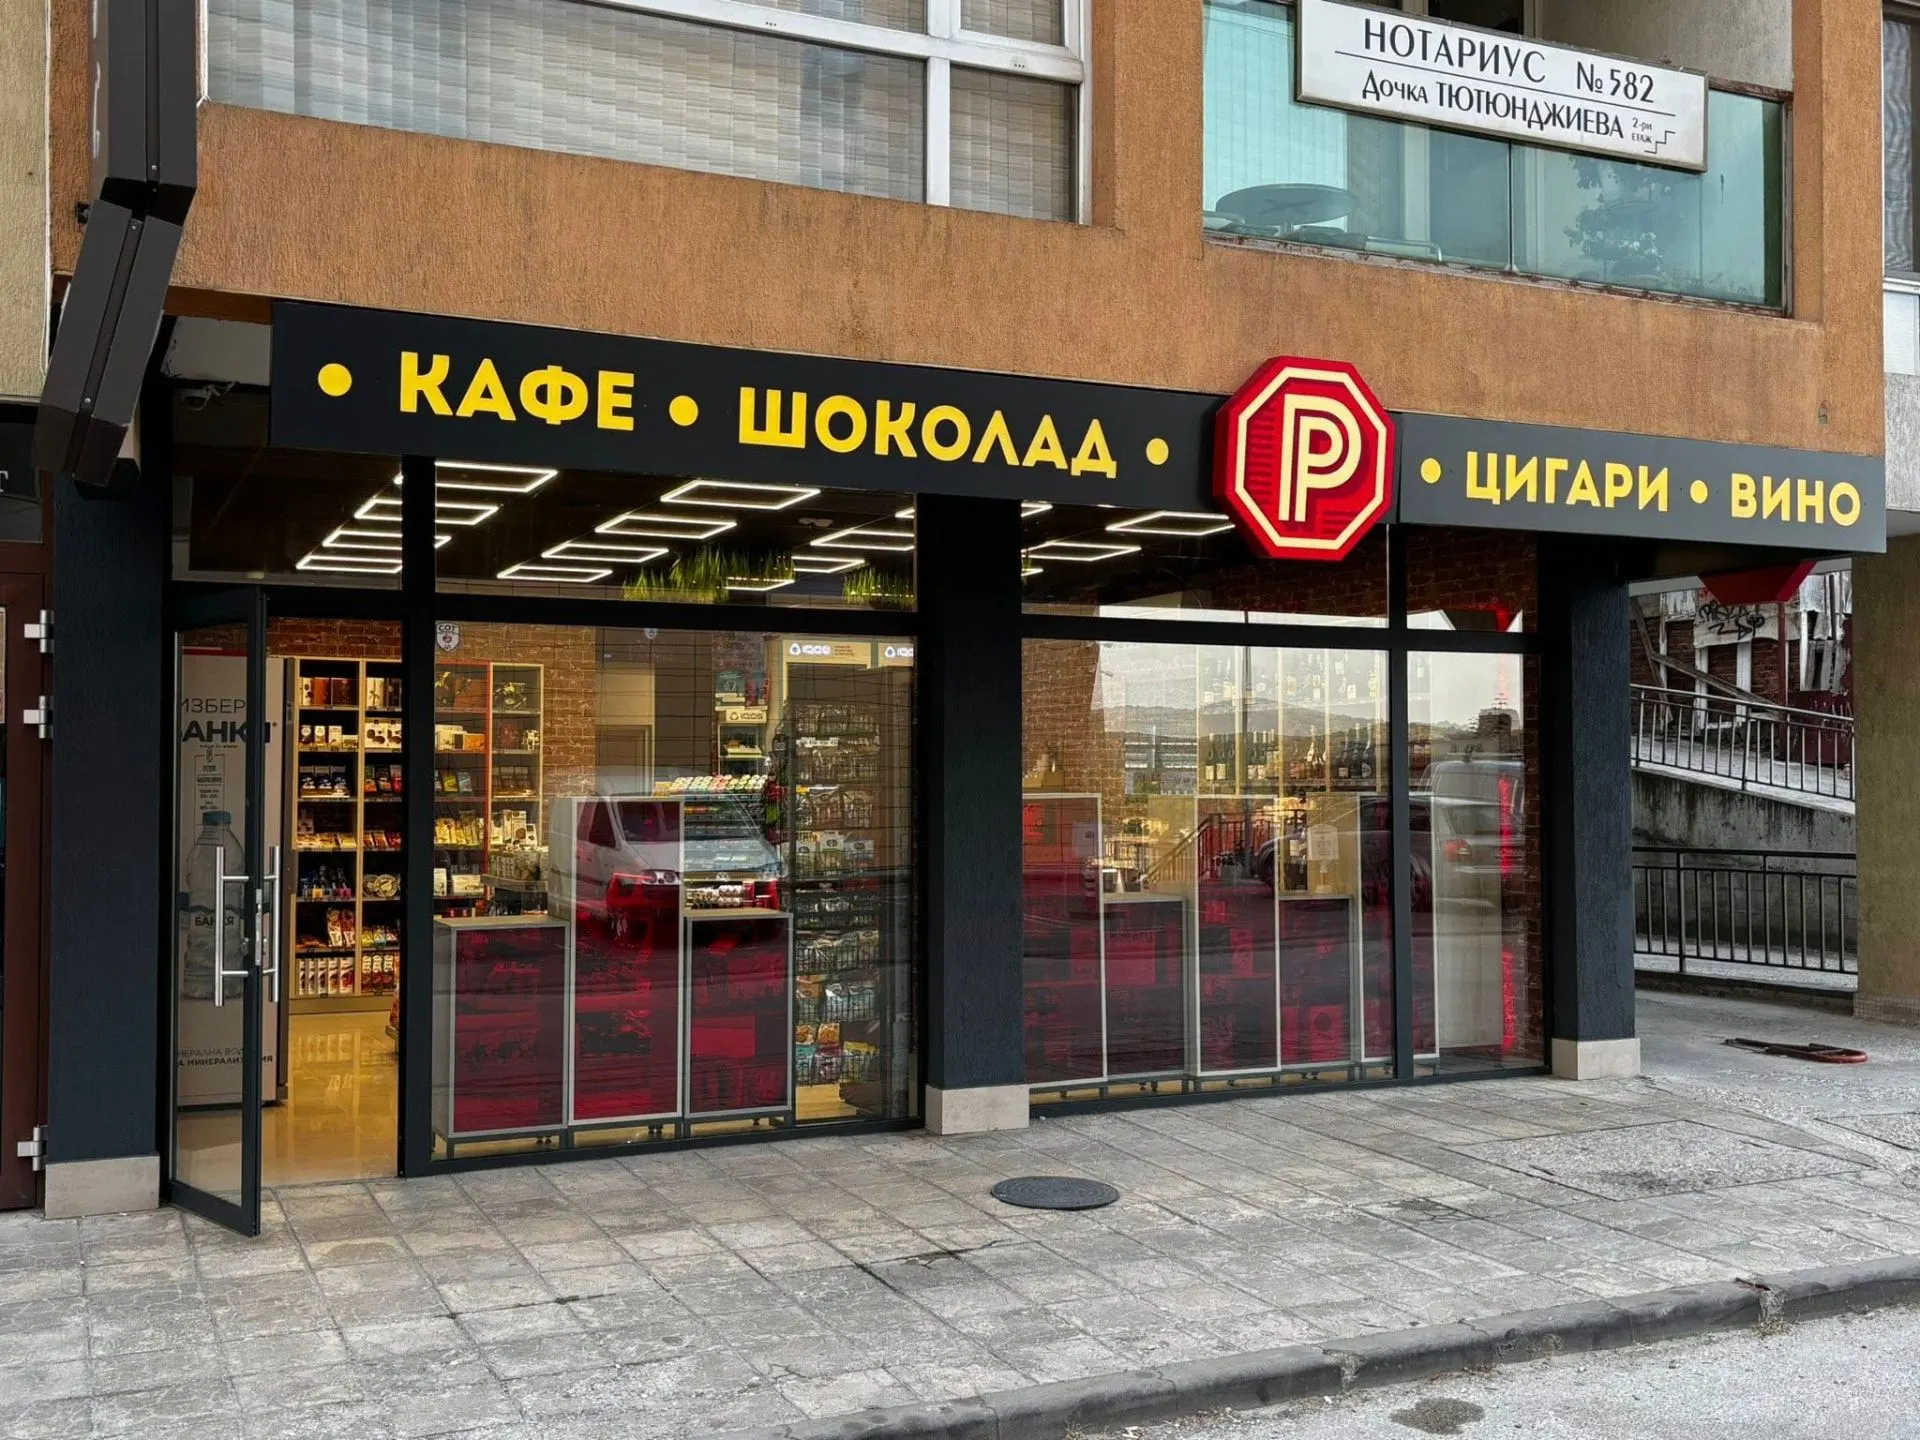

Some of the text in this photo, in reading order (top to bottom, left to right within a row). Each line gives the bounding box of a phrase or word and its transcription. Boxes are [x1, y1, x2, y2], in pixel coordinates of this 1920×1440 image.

[1364, 18, 1546, 83] НОТАРИУС
[1436, 80, 1625, 139] ТЮТЮНДЖИЕВА
[1631, 132, 1653, 144] ЕТАЖ
[400, 351, 1118, 479] КАФЕ ШОКОЛАД
[1466, 451, 1862, 527] ЦИГАРИ ВИНО
